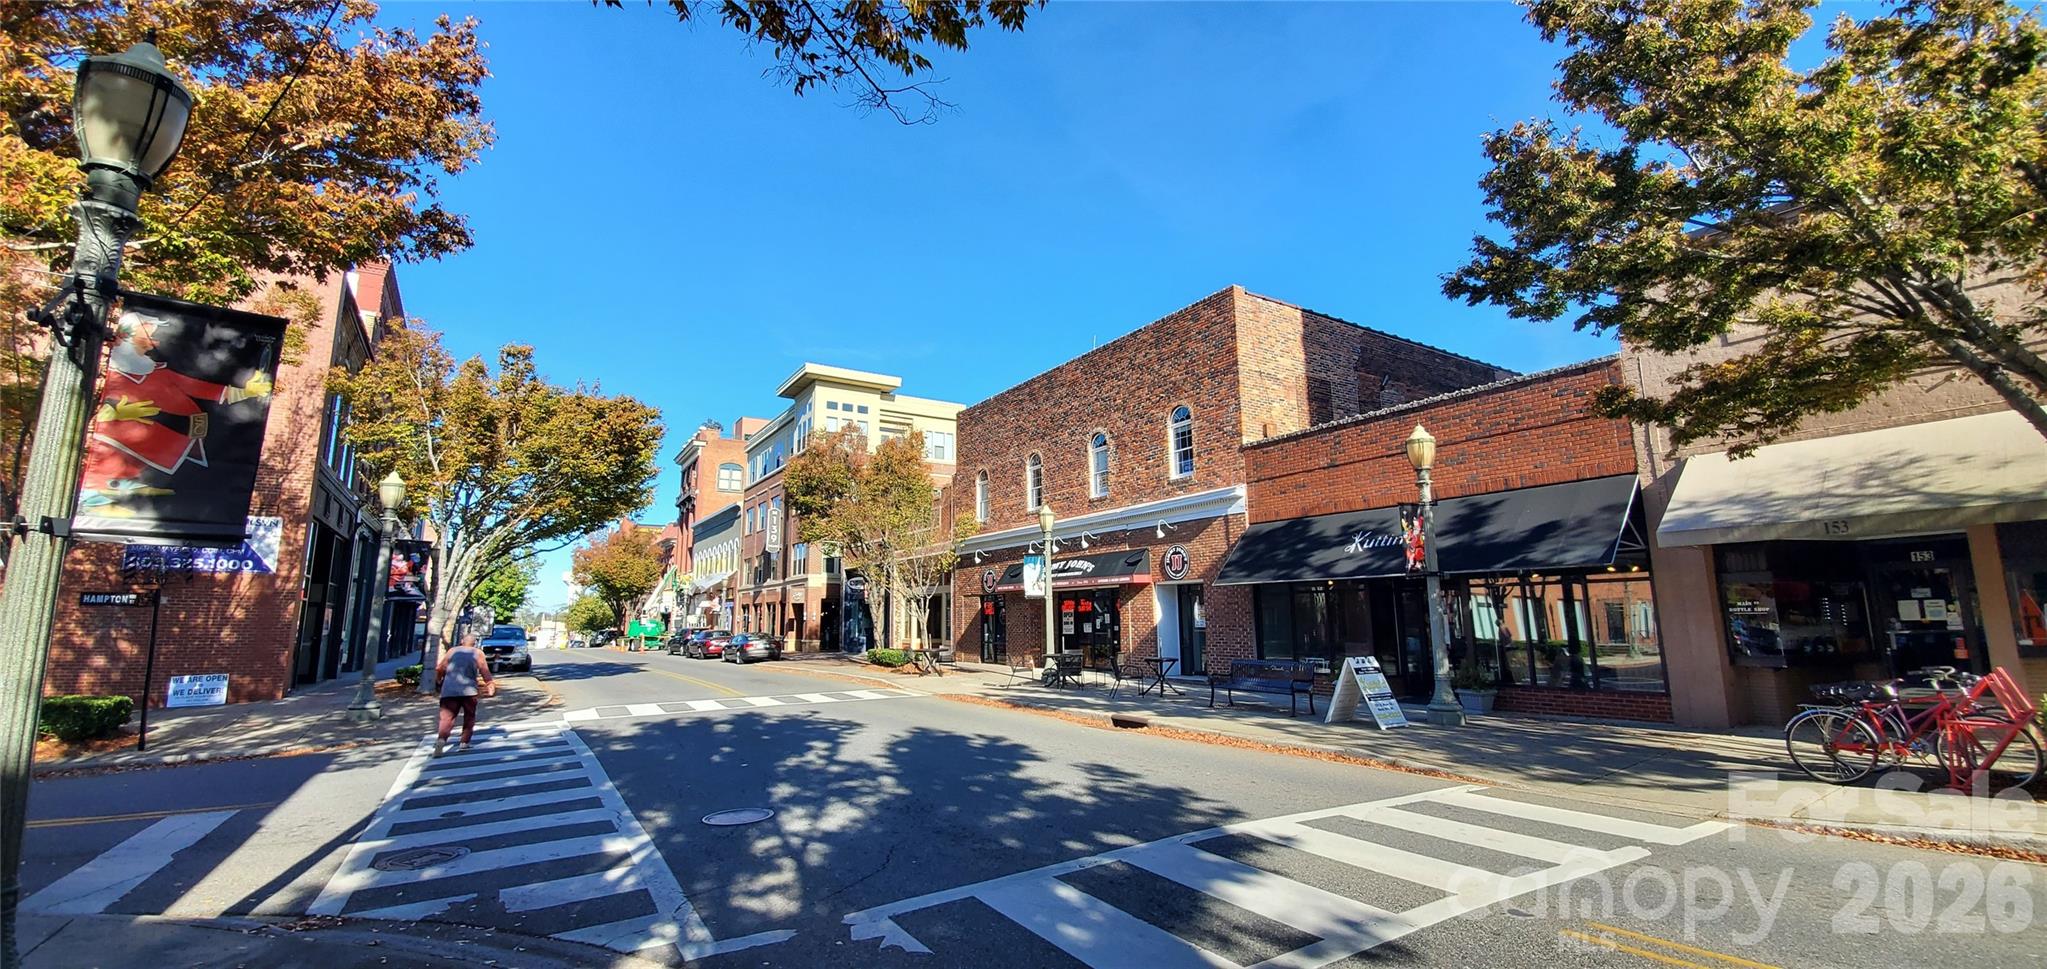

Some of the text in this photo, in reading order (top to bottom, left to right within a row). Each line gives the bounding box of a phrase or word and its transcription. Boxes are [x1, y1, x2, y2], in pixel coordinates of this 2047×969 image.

[770, 516, 778, 543] 139
[1823, 520, 1849, 535] 153
[1064, 559, 1096, 573] JOHN'S
[83, 594, 129, 604] HAMPTON
[172, 688, 185, 697] WE
